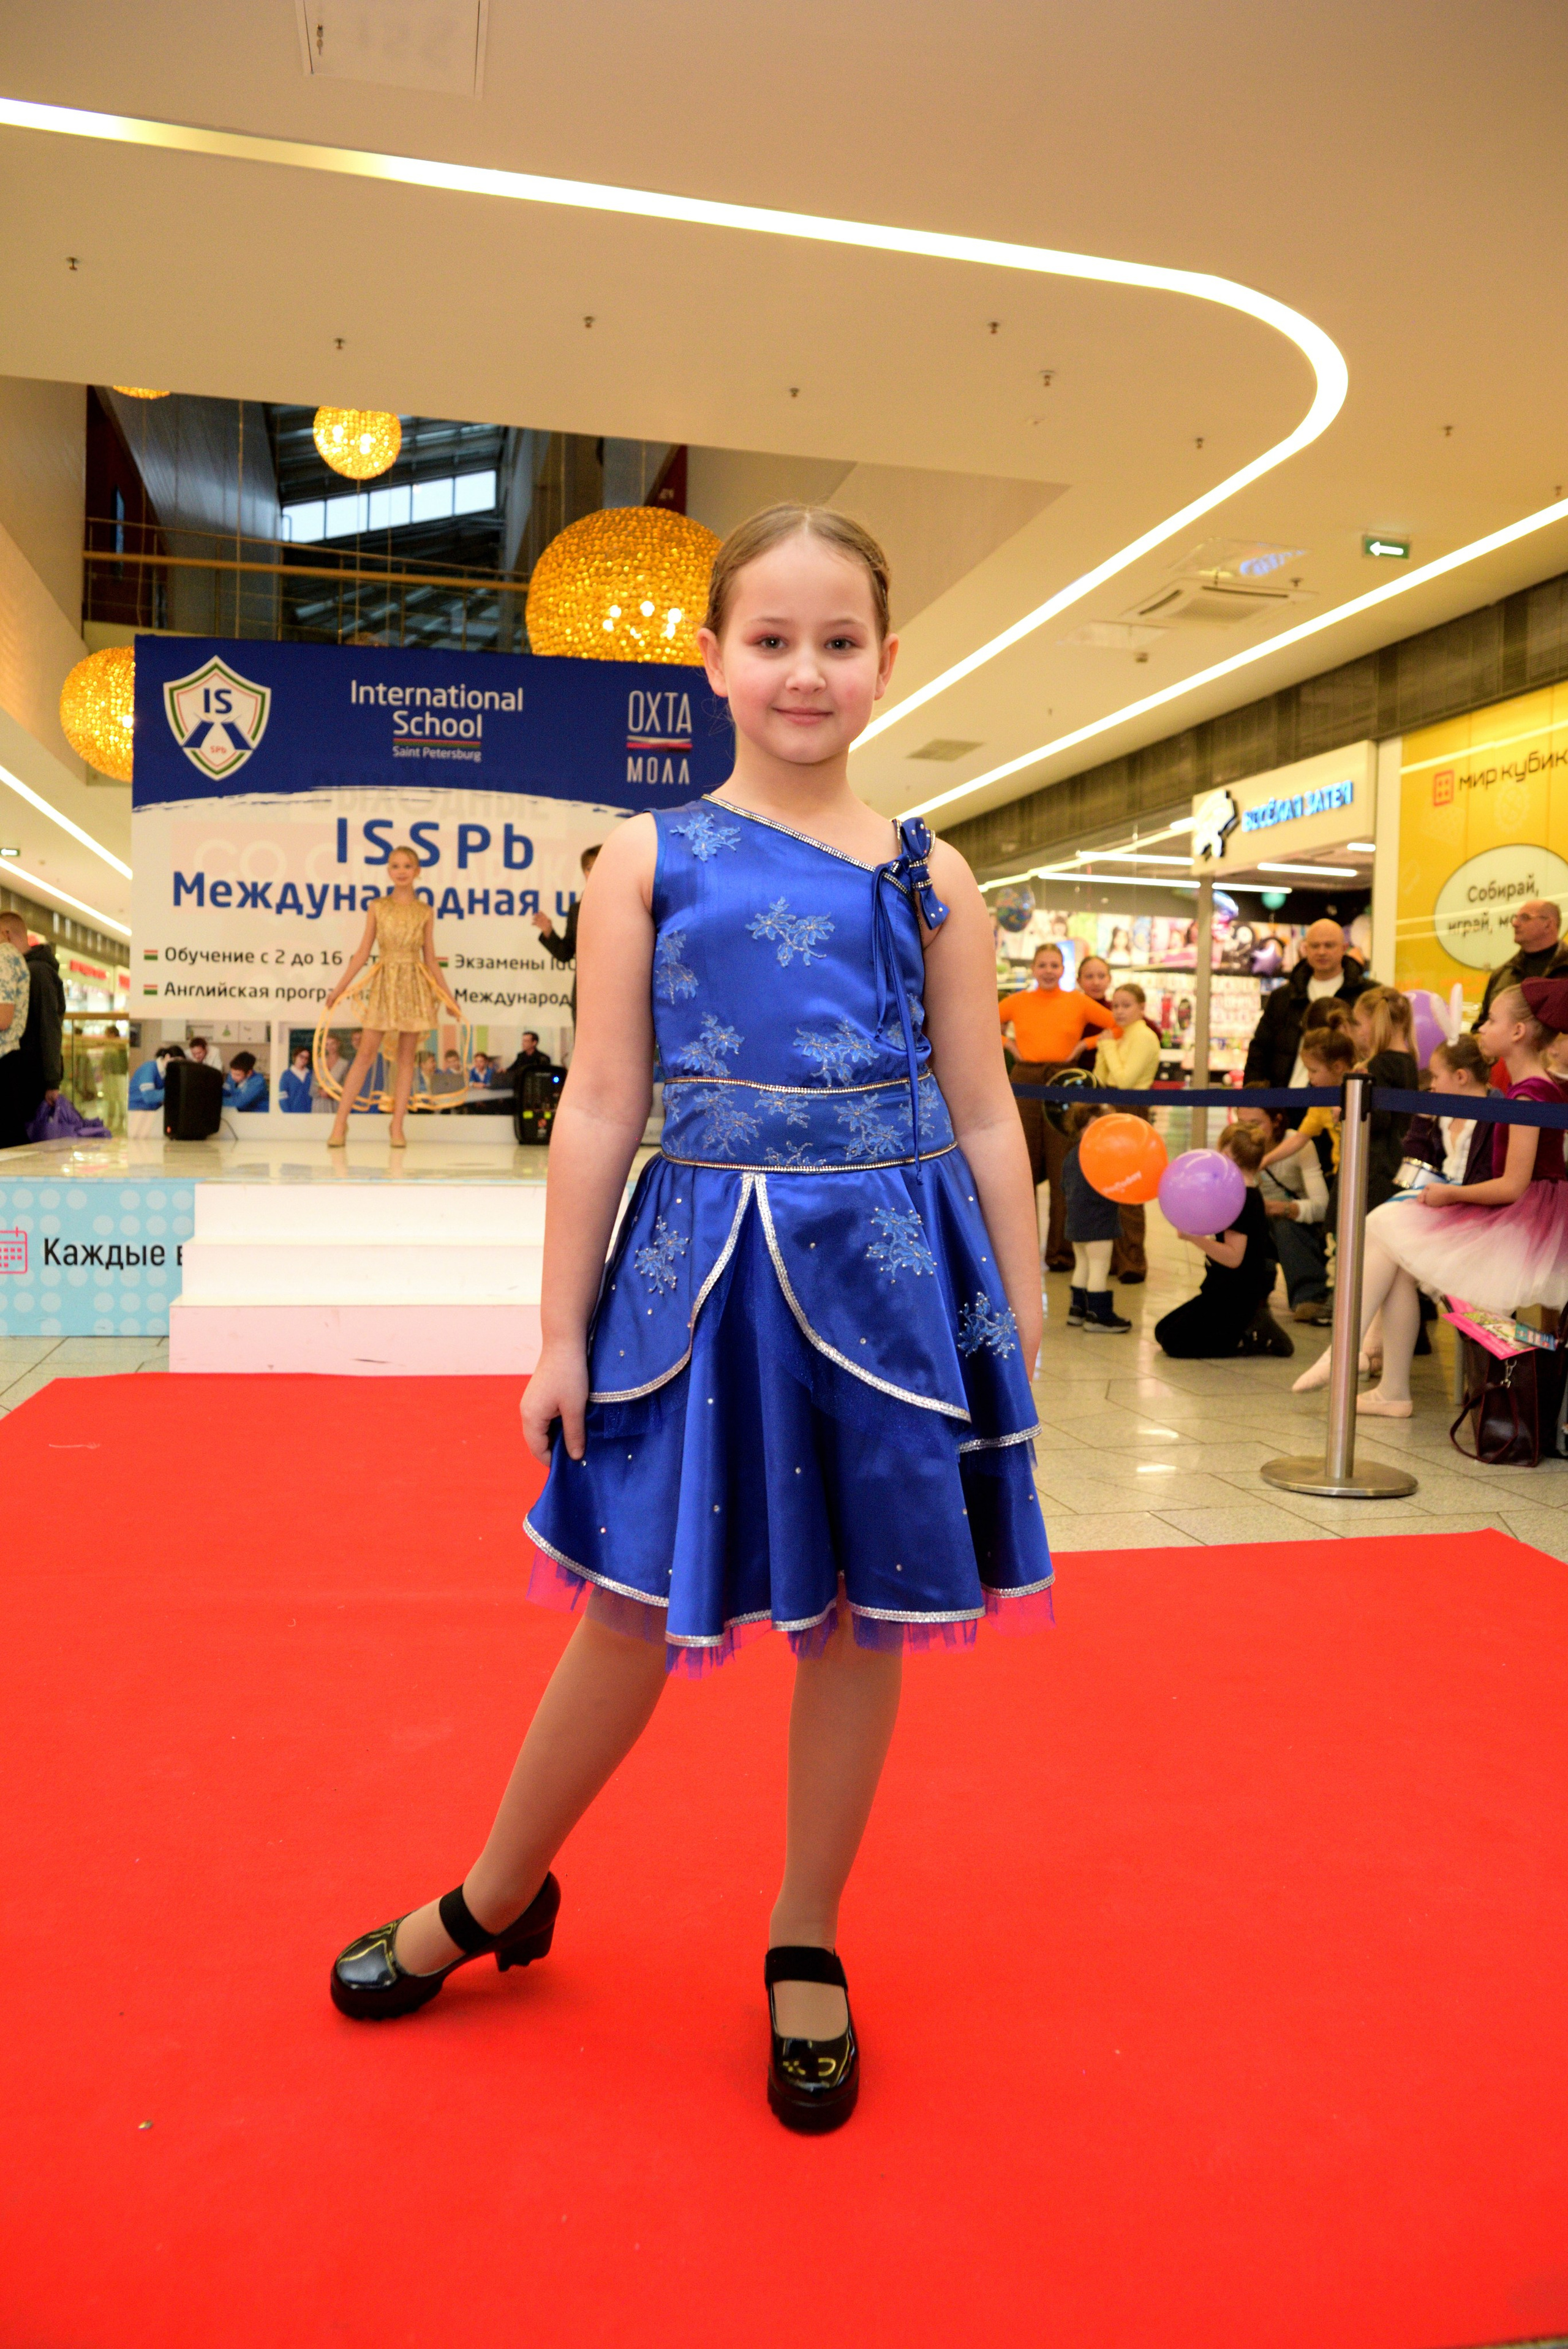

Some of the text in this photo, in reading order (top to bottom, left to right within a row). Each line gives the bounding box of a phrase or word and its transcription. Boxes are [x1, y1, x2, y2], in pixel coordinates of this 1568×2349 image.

[203, 688, 233, 714] IS
[351, 679, 524, 712] International
[393, 710, 483, 739] School
[628, 690, 692, 733] ОХТА
[392, 745, 482, 763] Saint Petersburg
[336, 817, 534, 870] ISSPb
[173, 871, 540, 920] Междунаодная
[1468, 874, 1539, 902] Собирай,
[165, 947, 255, 965] Обучение
[261, 952, 268, 963] с
[276, 949, 285, 964] 2
[291, 952, 314, 966] до
[321, 951, 342, 965] 16
[454, 954, 545, 970] Экзамены
[164, 981, 269, 998] Английская
[43, 1237, 165, 1270] Каждые
